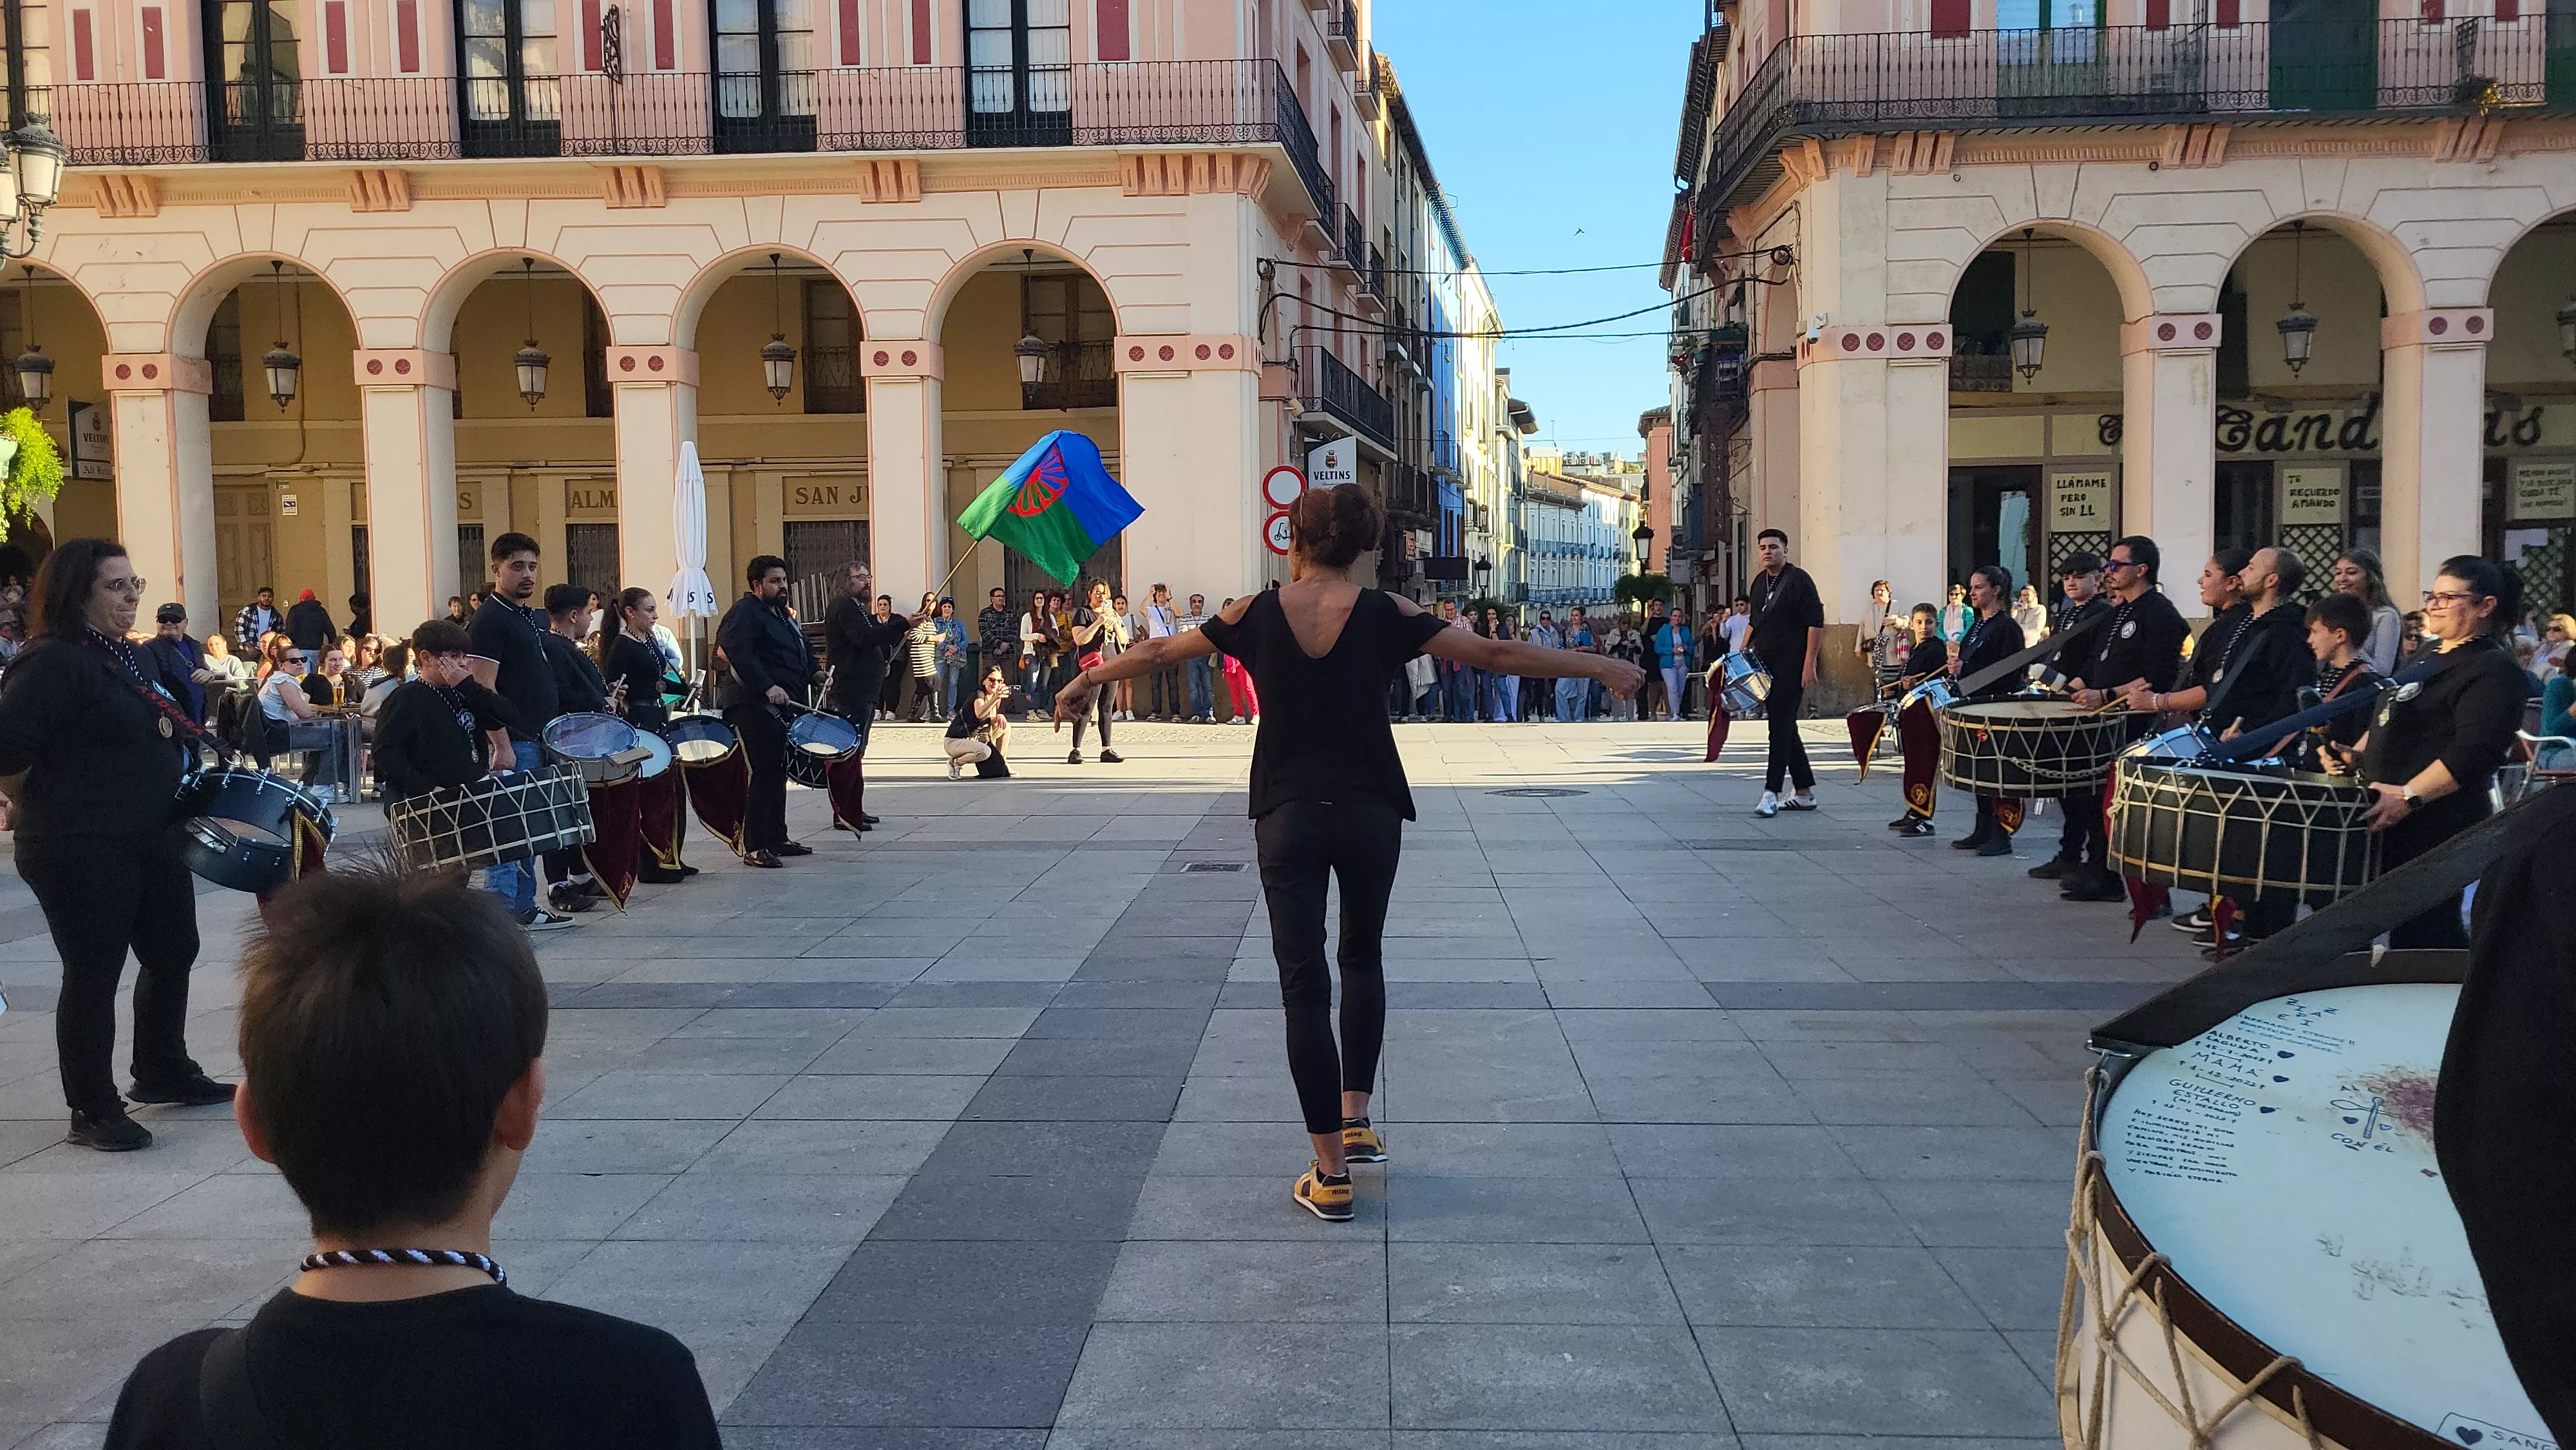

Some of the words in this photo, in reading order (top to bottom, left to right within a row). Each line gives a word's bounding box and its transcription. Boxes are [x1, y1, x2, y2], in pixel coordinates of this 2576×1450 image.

[1314, 471, 1350, 480] VELTINS
[2056, 476, 2107, 489] LLÁMAME
[571, 490, 618, 509] ALM
[795, 486, 839, 505] SAN
[849, 485, 869, 504] J
[2061, 493, 2087, 502] PERO
[2059, 506, 2076, 516] SIN
[2079, 504, 2096, 516] LL
[2206, 1035, 2259, 1053] LAGUNA
[2209, 1030, 2271, 1049] ALBERTO
[2168, 1078, 2256, 1106] GUILLERMO
[2173, 1089, 2240, 1109] ESTALLO
[2331, 1133, 2368, 1147] CON
